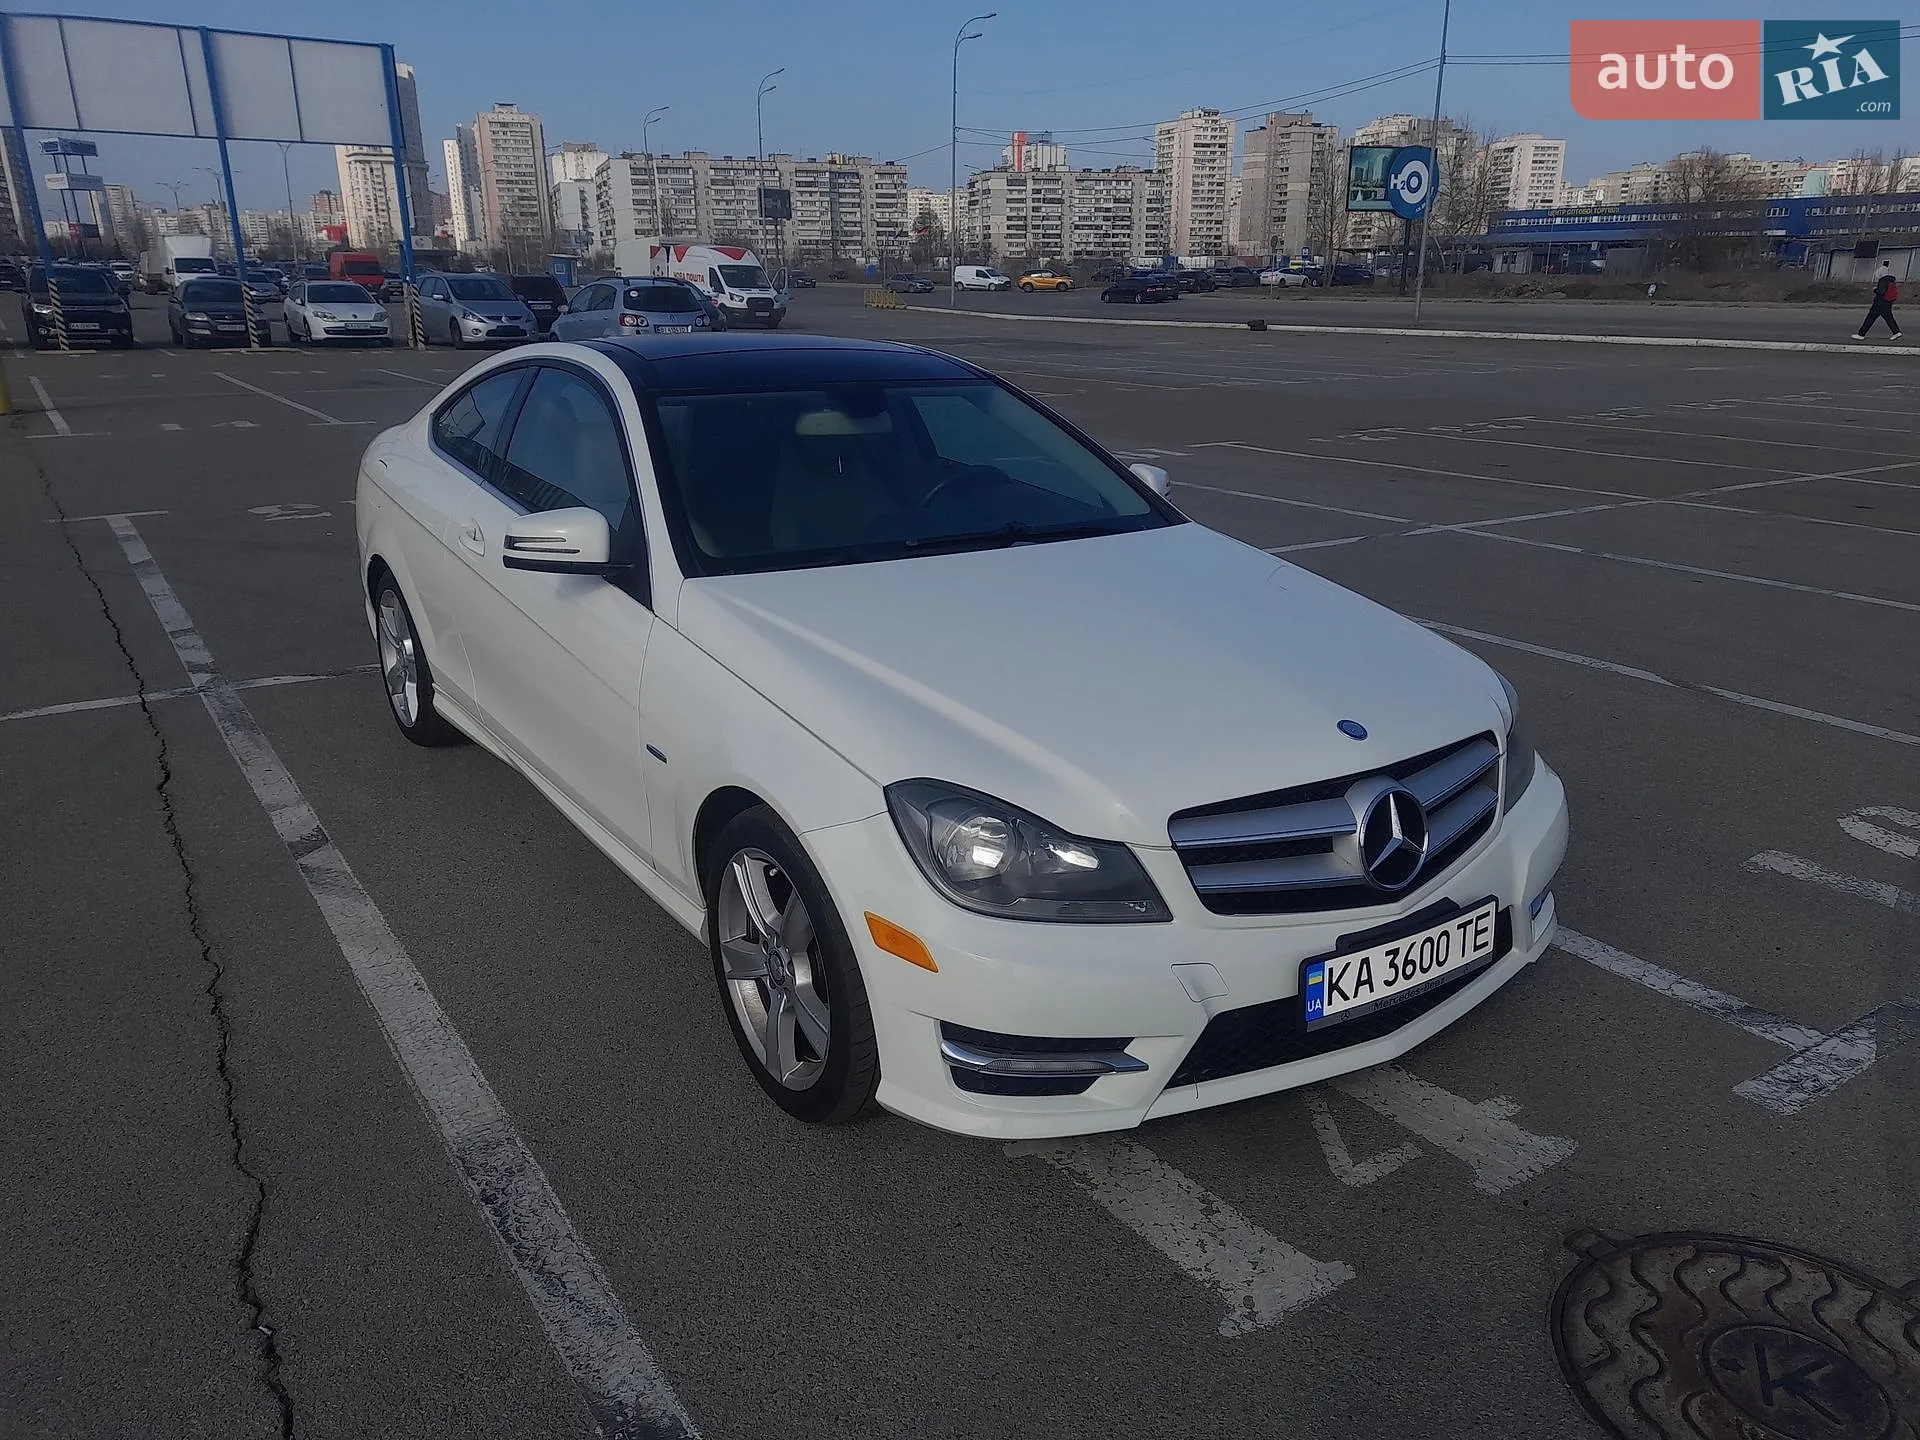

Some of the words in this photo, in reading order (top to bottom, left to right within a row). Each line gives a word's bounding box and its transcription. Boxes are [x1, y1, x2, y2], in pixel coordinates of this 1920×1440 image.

[1326, 957, 1375, 1006] KA
[1383, 930, 1449, 987] 3600
[1457, 910, 1491, 958] TE
[1307, 998, 1322, 1012] UA
[1371, 976, 1447, 1011] Mercedes-Benz
